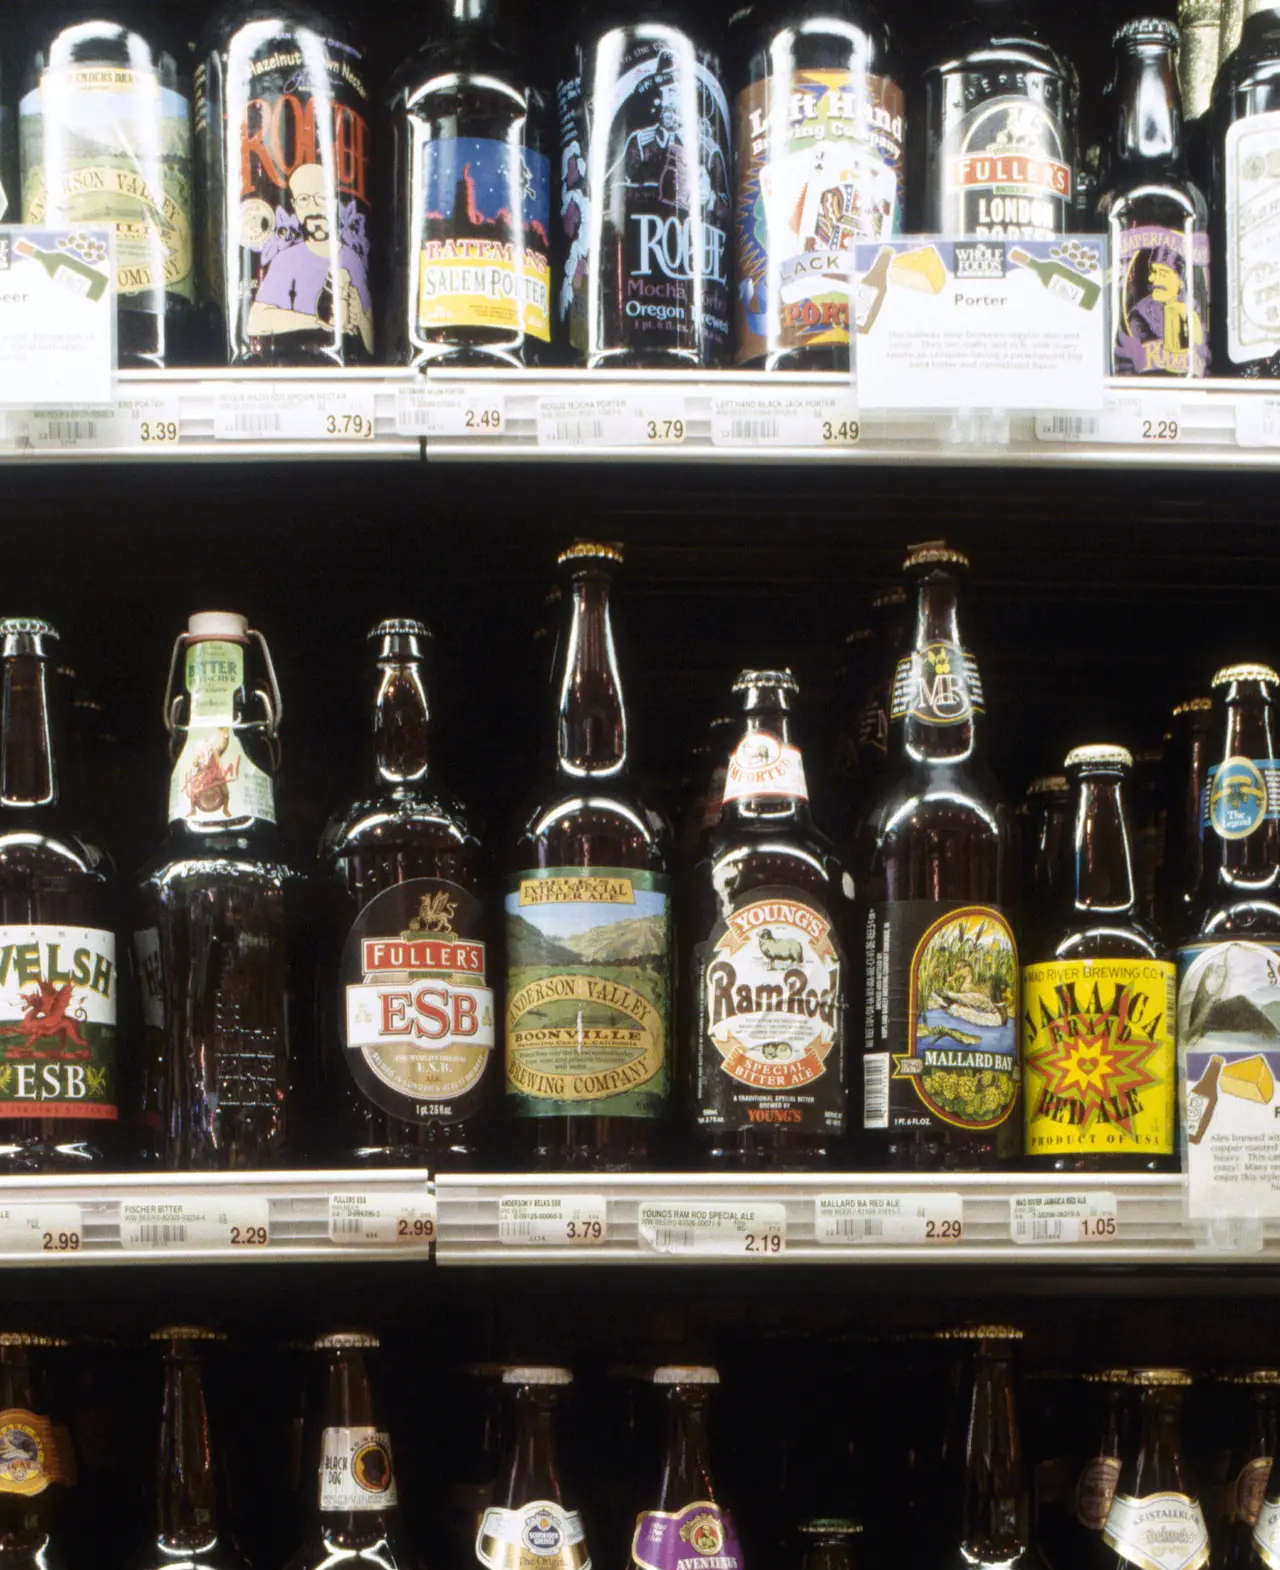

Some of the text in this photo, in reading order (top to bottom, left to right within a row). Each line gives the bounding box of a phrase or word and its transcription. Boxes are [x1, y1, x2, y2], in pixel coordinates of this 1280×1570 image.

[979, 197, 1054, 226] LONDON
[955, 246, 1004, 262] WHOLE
[958, 260, 1000, 275] FOODS
[0, 290, 29, 303] Beer
[954, 293, 1008, 307] Porter
[625, 301, 685, 320] Oregon
[141, 423, 177, 441] 3.39
[648, 421, 684, 439] 3.79
[1142, 421, 1178, 439] 2.29
[735, 909, 823, 940] YOUNG'S
[374, 945, 480, 971] FULLER'S
[379, 990, 479, 1038] ESB
[1025, 979, 1160, 1041] JAMAICA
[515, 1028, 642, 1043] BOONVILLE
[742, 1060, 805, 1076] SPECIAL
[923, 1051, 1014, 1071] MALLARD BAY
[14, 1062, 88, 1101] ESB
[508, 1061, 650, 1098] BREWING COMPANY
[747, 1108, 802, 1124] YOUNG'S
[124, 1205, 183, 1215] FISCHER BITTER
[1081, 1217, 1116, 1236] 1.05
[230, 1227, 267, 1246] 2.29
[745, 1234, 781, 1254] 2.19
